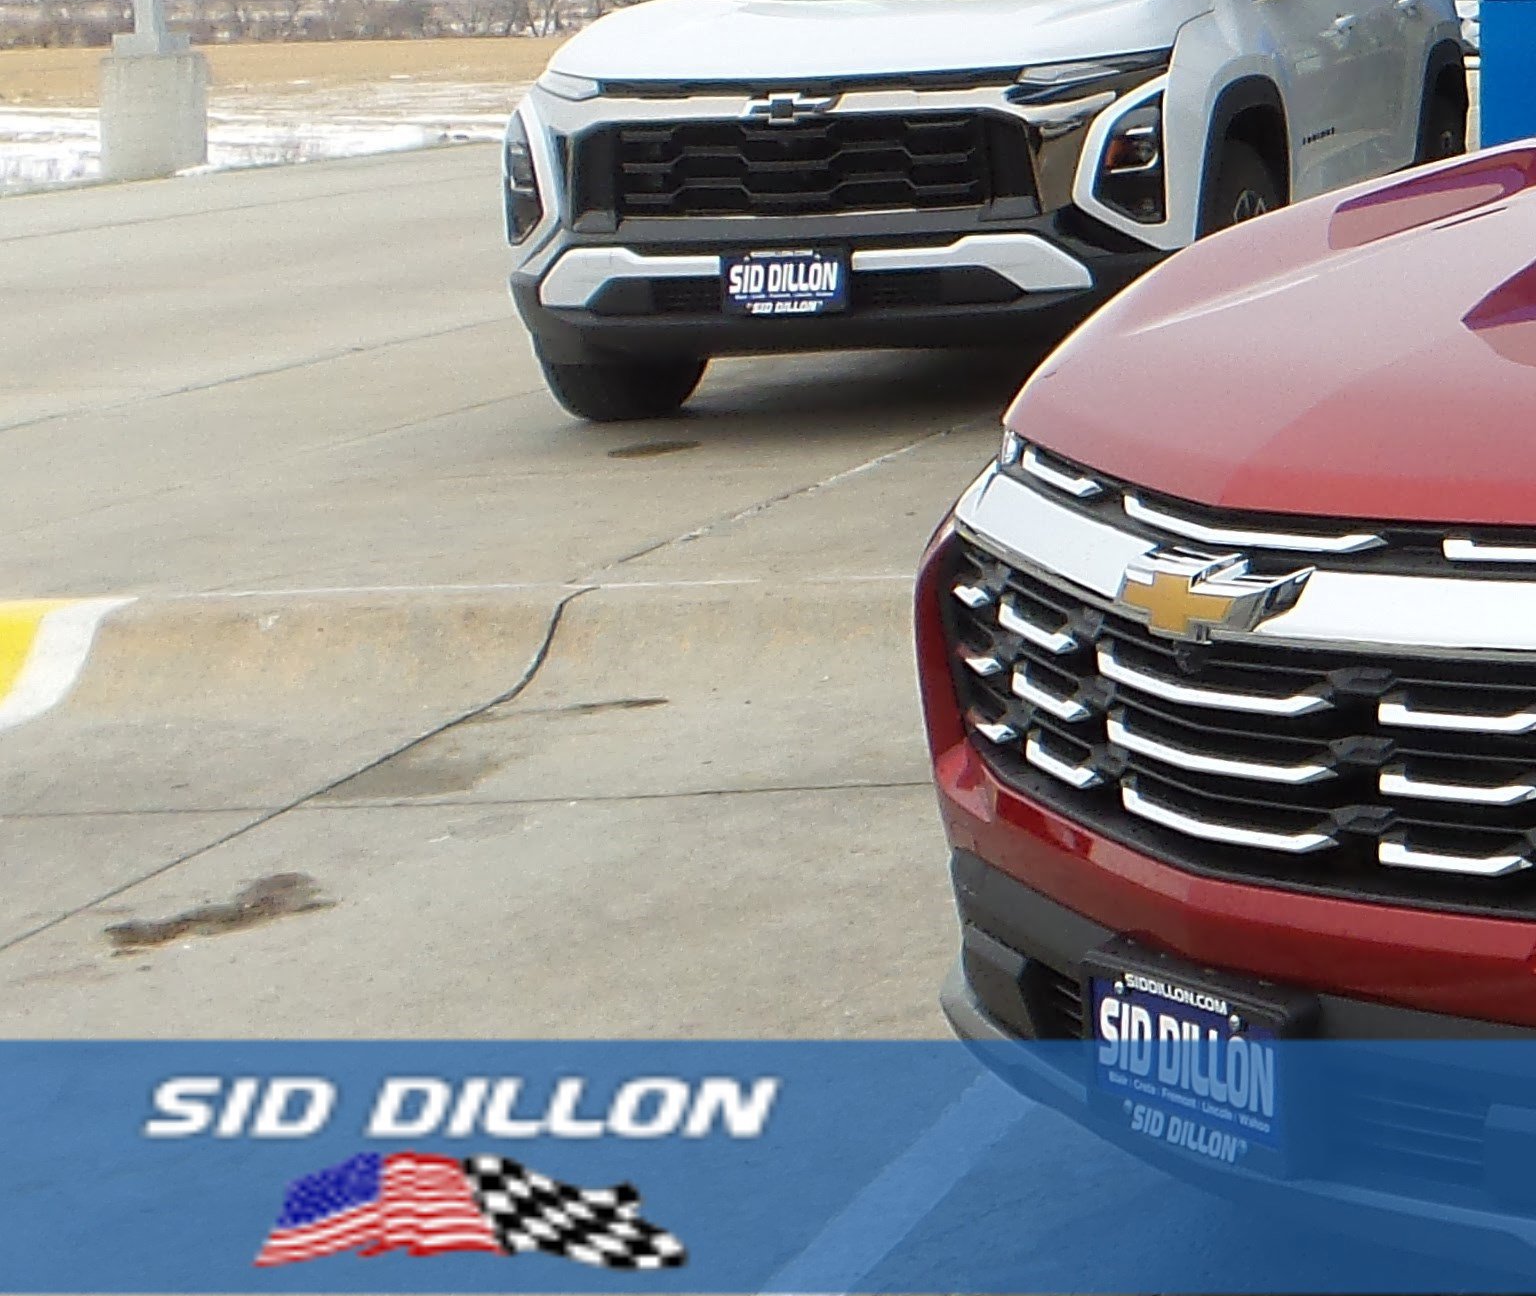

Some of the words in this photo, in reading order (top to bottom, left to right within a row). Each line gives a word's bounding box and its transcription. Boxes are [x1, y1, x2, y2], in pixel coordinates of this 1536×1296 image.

[729, 264, 765, 294] SID
[767, 262, 838, 292] DILLON
[1124, 972, 1228, 1016] SIDDILLON.COM
[1099, 996, 1152, 1076] SID
[1158, 1013, 1274, 1118] DILLON
